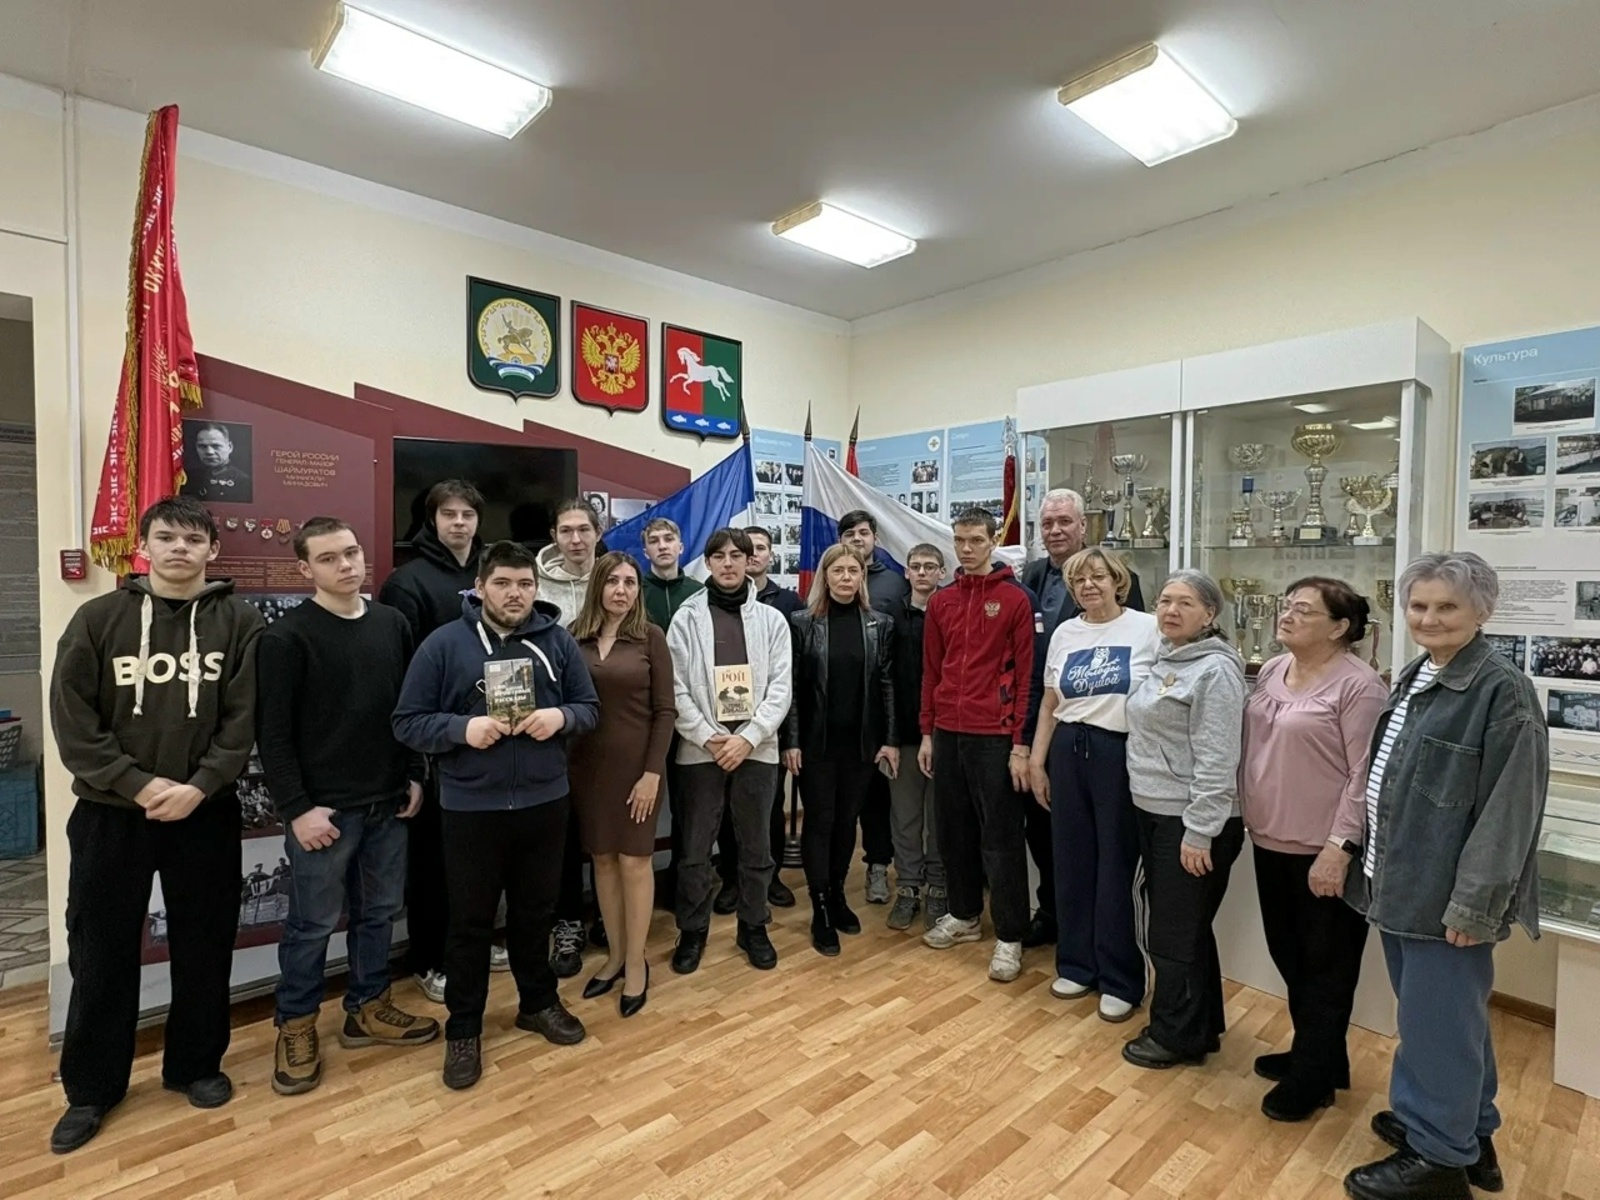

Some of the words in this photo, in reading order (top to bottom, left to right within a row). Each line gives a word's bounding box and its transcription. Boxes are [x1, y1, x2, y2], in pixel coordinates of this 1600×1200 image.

[1473, 347, 1538, 366] Культура
[270, 449, 300, 458] ГЕРОЙ
[302, 452, 340, 461] РОССИИ
[274, 465, 336, 476] ШАЙМУРАТОВ
[112, 651, 225, 686] BOSS
[1067, 664, 1122, 681] Молоды
[1073, 673, 1121, 696] Душой
